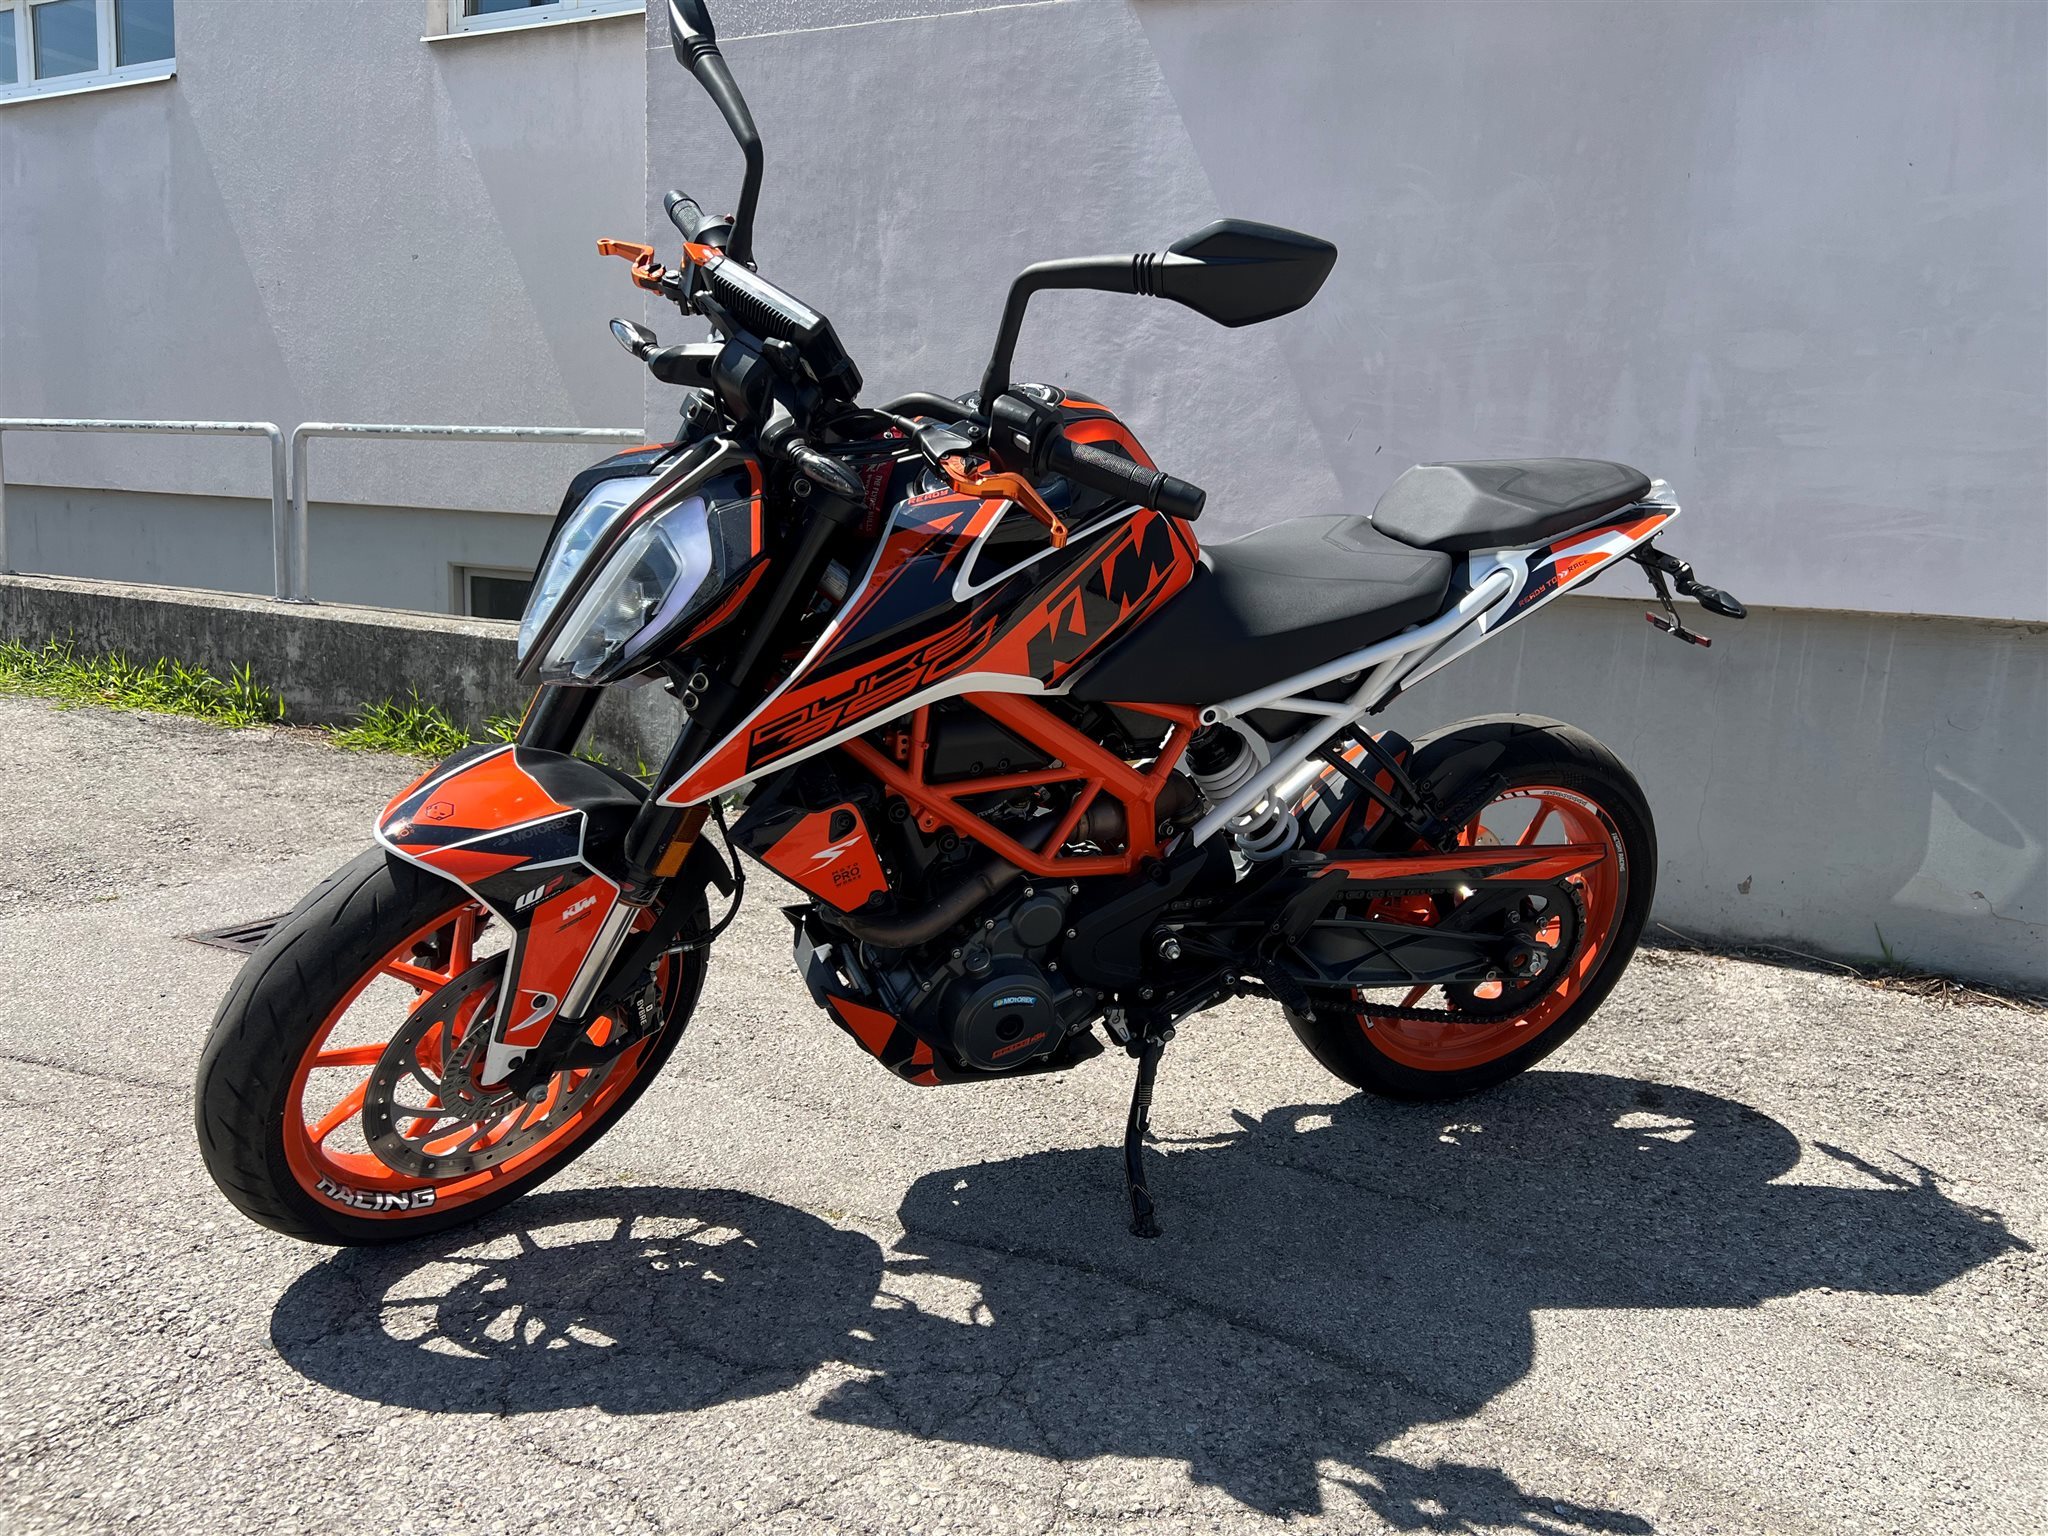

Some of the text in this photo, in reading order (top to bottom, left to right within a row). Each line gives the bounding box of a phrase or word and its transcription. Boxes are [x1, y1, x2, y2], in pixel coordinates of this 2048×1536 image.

[1027, 512, 1175, 681] KTM
[1518, 558, 1589, 608] READY TO RACE
[511, 816, 571, 843] MOTOREX
[1611, 832, 1622, 853] FACTORY
[833, 867, 861, 885] PRO
[562, 895, 597, 920] KTM
[636, 998, 647, 1026] BYBRE
[1003, 996, 1034, 1004] MOTOREX
[315, 1175, 435, 1211] RACING
